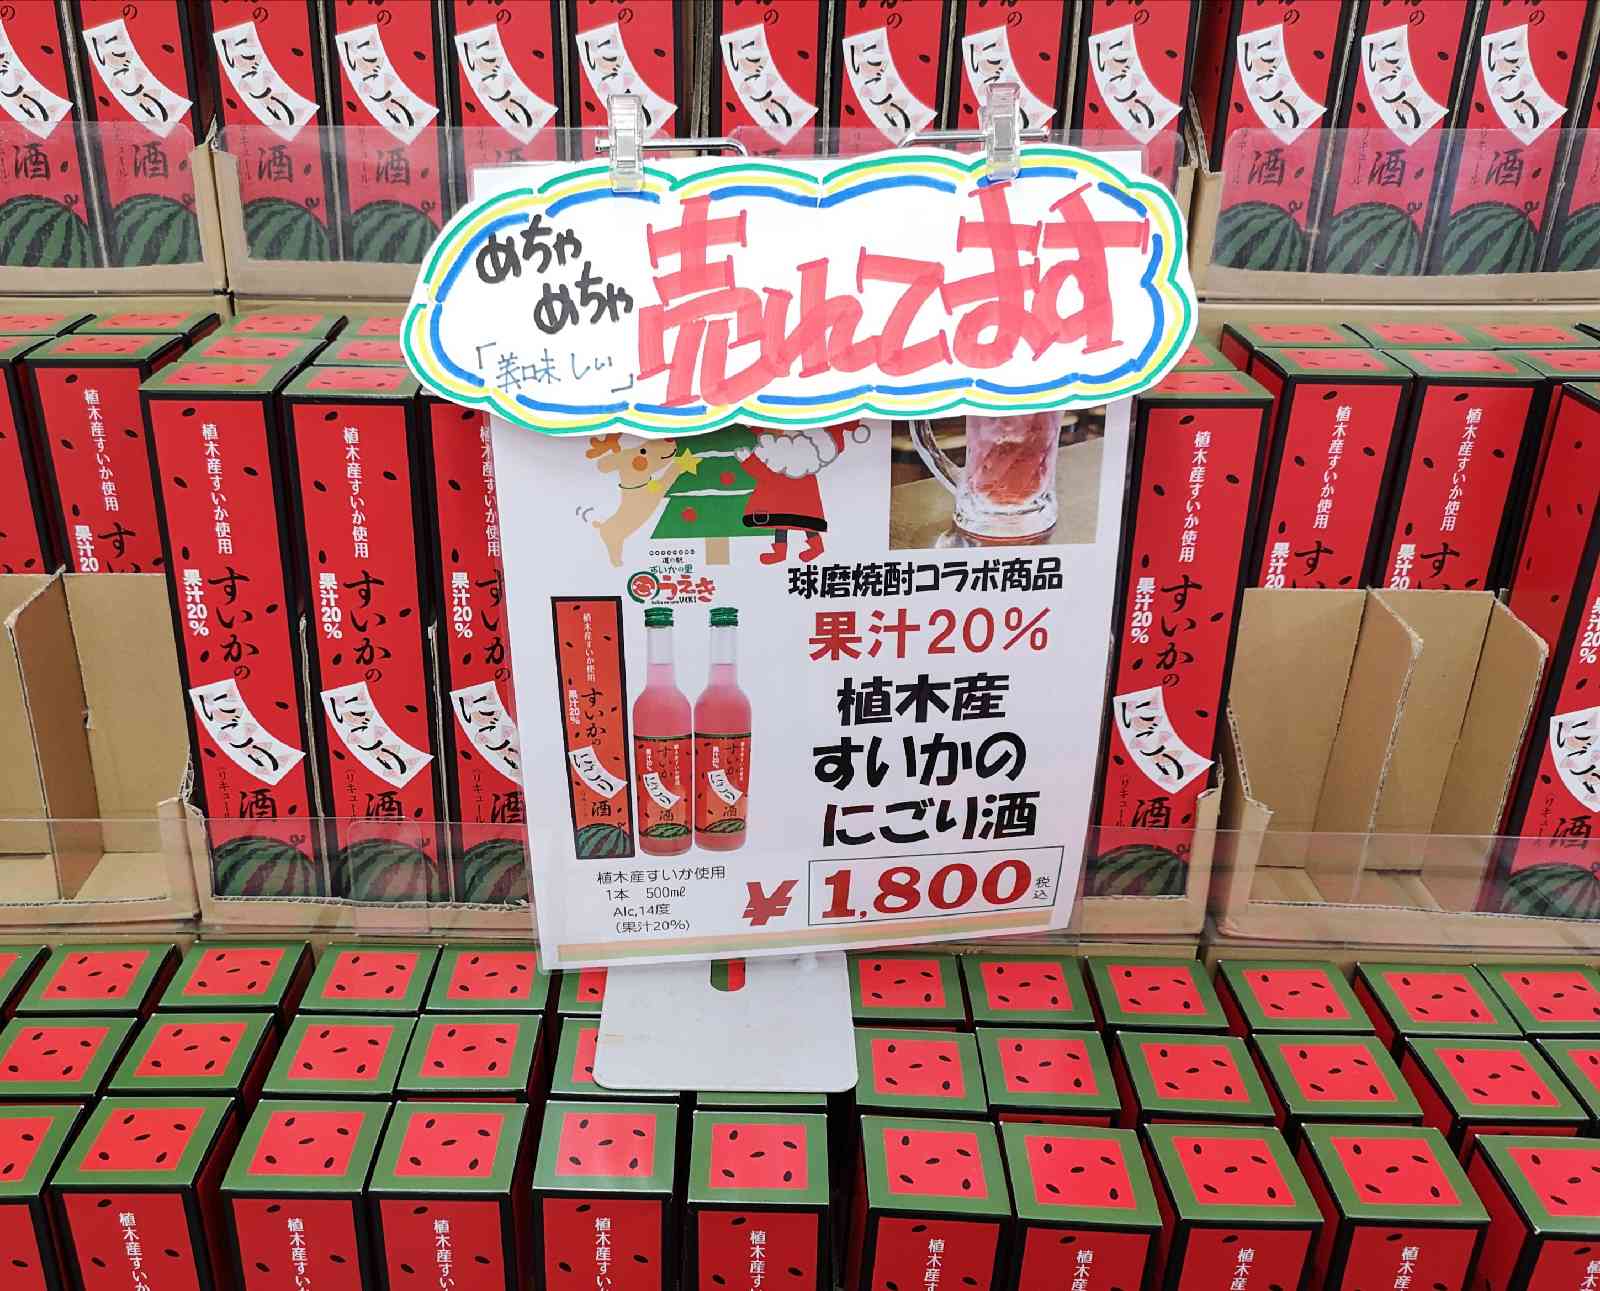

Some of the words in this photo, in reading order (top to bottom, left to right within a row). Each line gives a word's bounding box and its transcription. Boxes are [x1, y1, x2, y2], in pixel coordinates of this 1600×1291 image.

[92, 36, 168, 121] にごり
[222, 38, 295, 125] にごり
[344, 40, 414, 127] にごり
[464, 40, 533, 127] にごり
[729, 41, 792, 127] にごり
[851, 43, 911, 129] にごり
[1096, 41, 1156, 129] にごり
[1244, 40, 1300, 129] にごり
[1368, 40, 1421, 129] にごり
[1488, 40, 1540, 129] にごり
[475, 213, 582, 284] めちゃ
[533, 261, 633, 334] めちゃ
[636, 181, 1149, 407] 売れてます
[83, 388, 119, 512] 植木産すいか使用
[202, 423, 233, 556] 植木産すいか使用
[1312, 404, 1351, 530] 植木産すいか使用
[1440, 407, 1482, 532] 植木産すいか使用
[343, 425, 369, 560] 植木産すいか使用
[1178, 430, 1212, 564] 植木産すいか使用
[183, 568, 209, 638] 果汁20%
[318, 571, 343, 640] 果汁20%
[451, 571, 474, 640] 果汁20%
[658, 574, 716, 603] うえき
[787, 557, 1064, 599] 球磨焼酎コラボ商品
[1130, 576, 1156, 645] 果汁20%
[208, 566, 260, 680] すいかの
[342, 569, 391, 682] すいかの
[808, 606, 1052, 662] 果汁20%
[1154, 573, 1203, 687] すいかの
[199, 693, 280, 772] にごり
[329, 696, 407, 776] にごり
[836, 671, 1010, 726] 植木産
[812, 731, 1028, 792] すいかの
[1120, 700, 1185, 781] にごり
[821, 791, 1041, 847] にごり酒
[597, 865, 726, 885] 植木産すいか使用
[605, 888, 631, 901] 1本
[821, 859, 1032, 920] 1,800
[616, 919, 691, 934] (果汁20%)
[287, 1217, 311, 1291] 植木産すい
